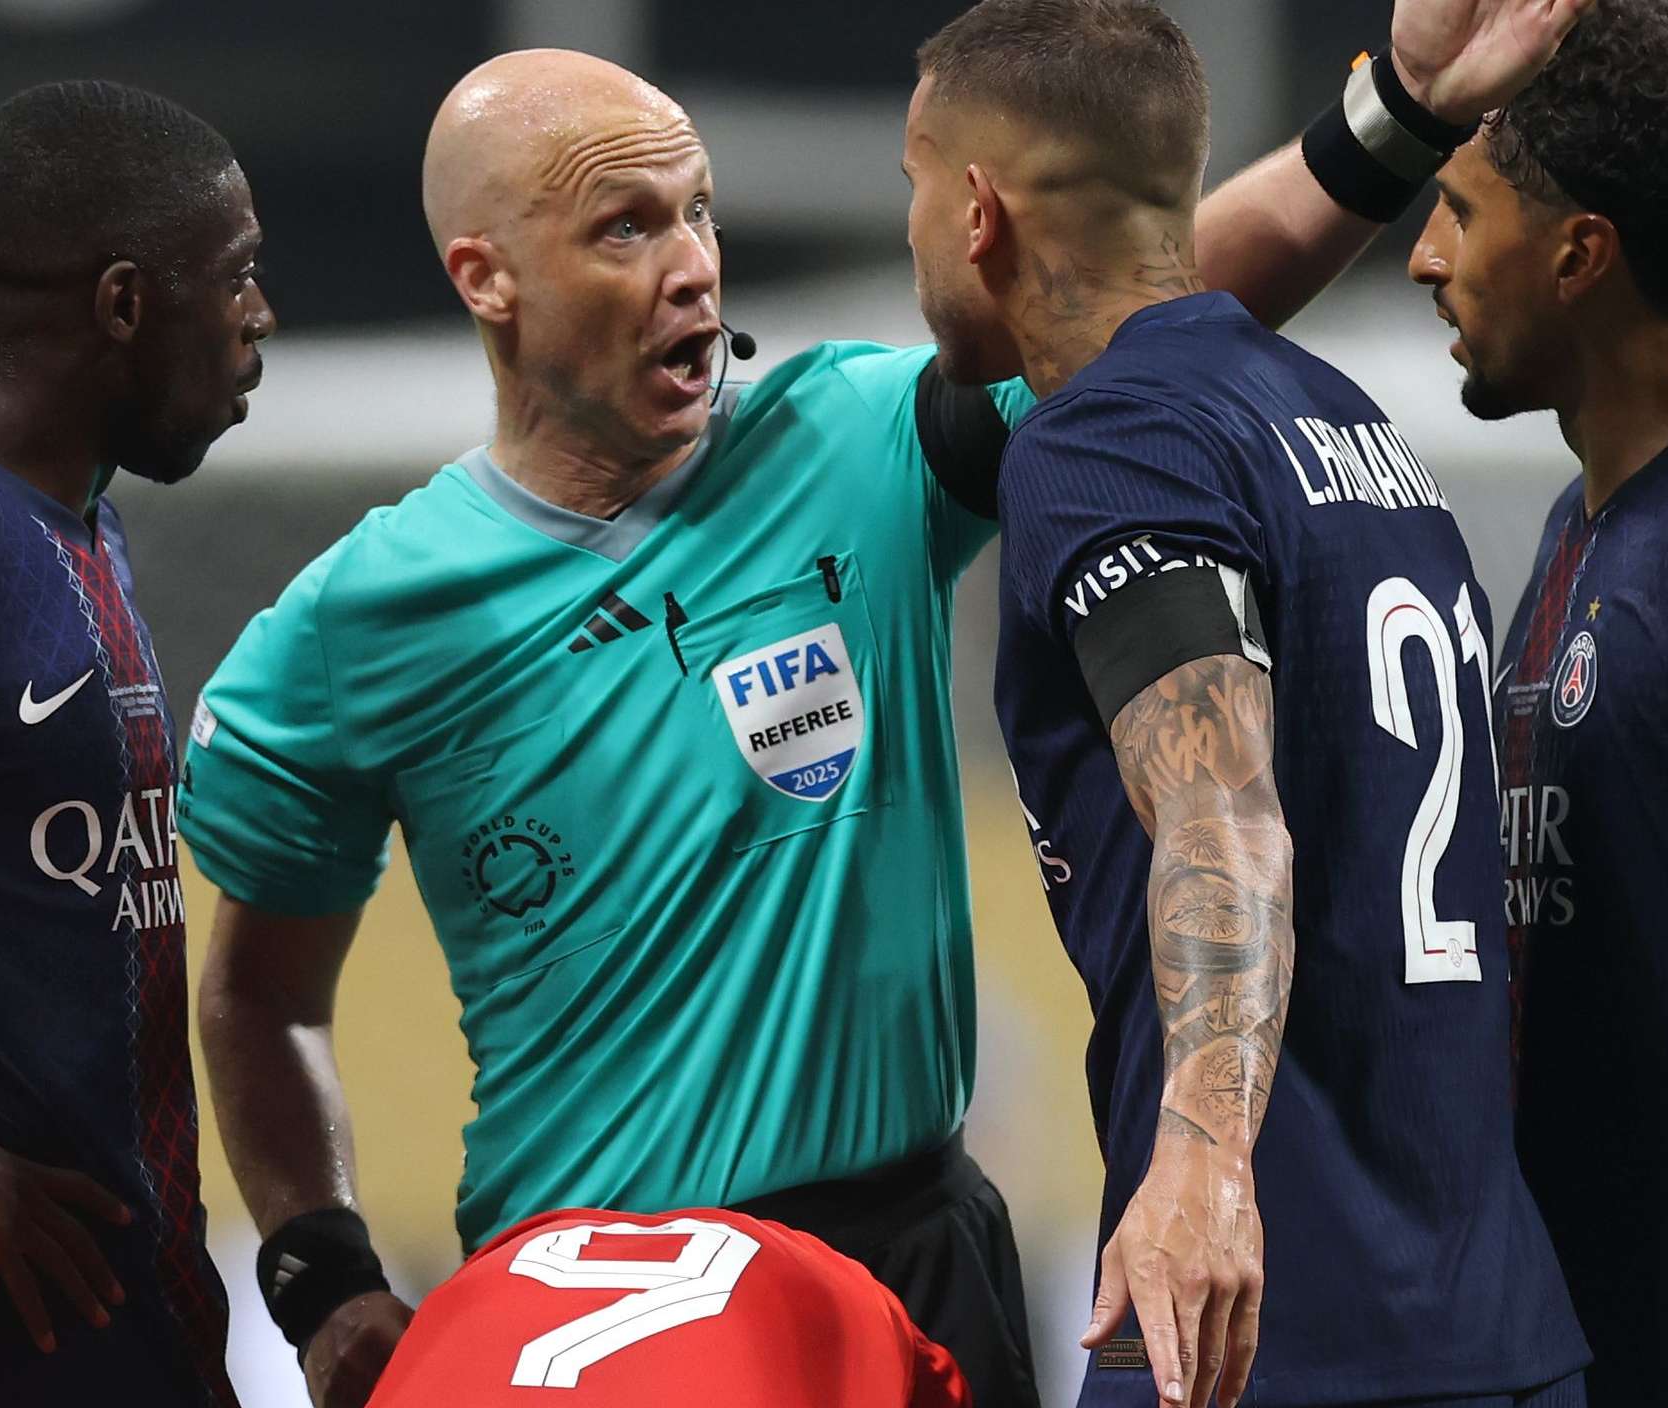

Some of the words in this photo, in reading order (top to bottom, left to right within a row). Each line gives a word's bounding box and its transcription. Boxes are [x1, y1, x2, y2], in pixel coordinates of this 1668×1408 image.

[1064, 534, 1163, 617] VISIT
[727, 641, 840, 708] FIFA
[749, 699, 854, 753] REFEREE
[791, 761, 841, 792] 2025
[1366, 576, 1501, 984] 21
[30, 785, 179, 898] QATA
[461, 815, 516, 859] WORLD
[525, 818, 562, 845] CUP
[111, 876, 186, 932] AIRW
